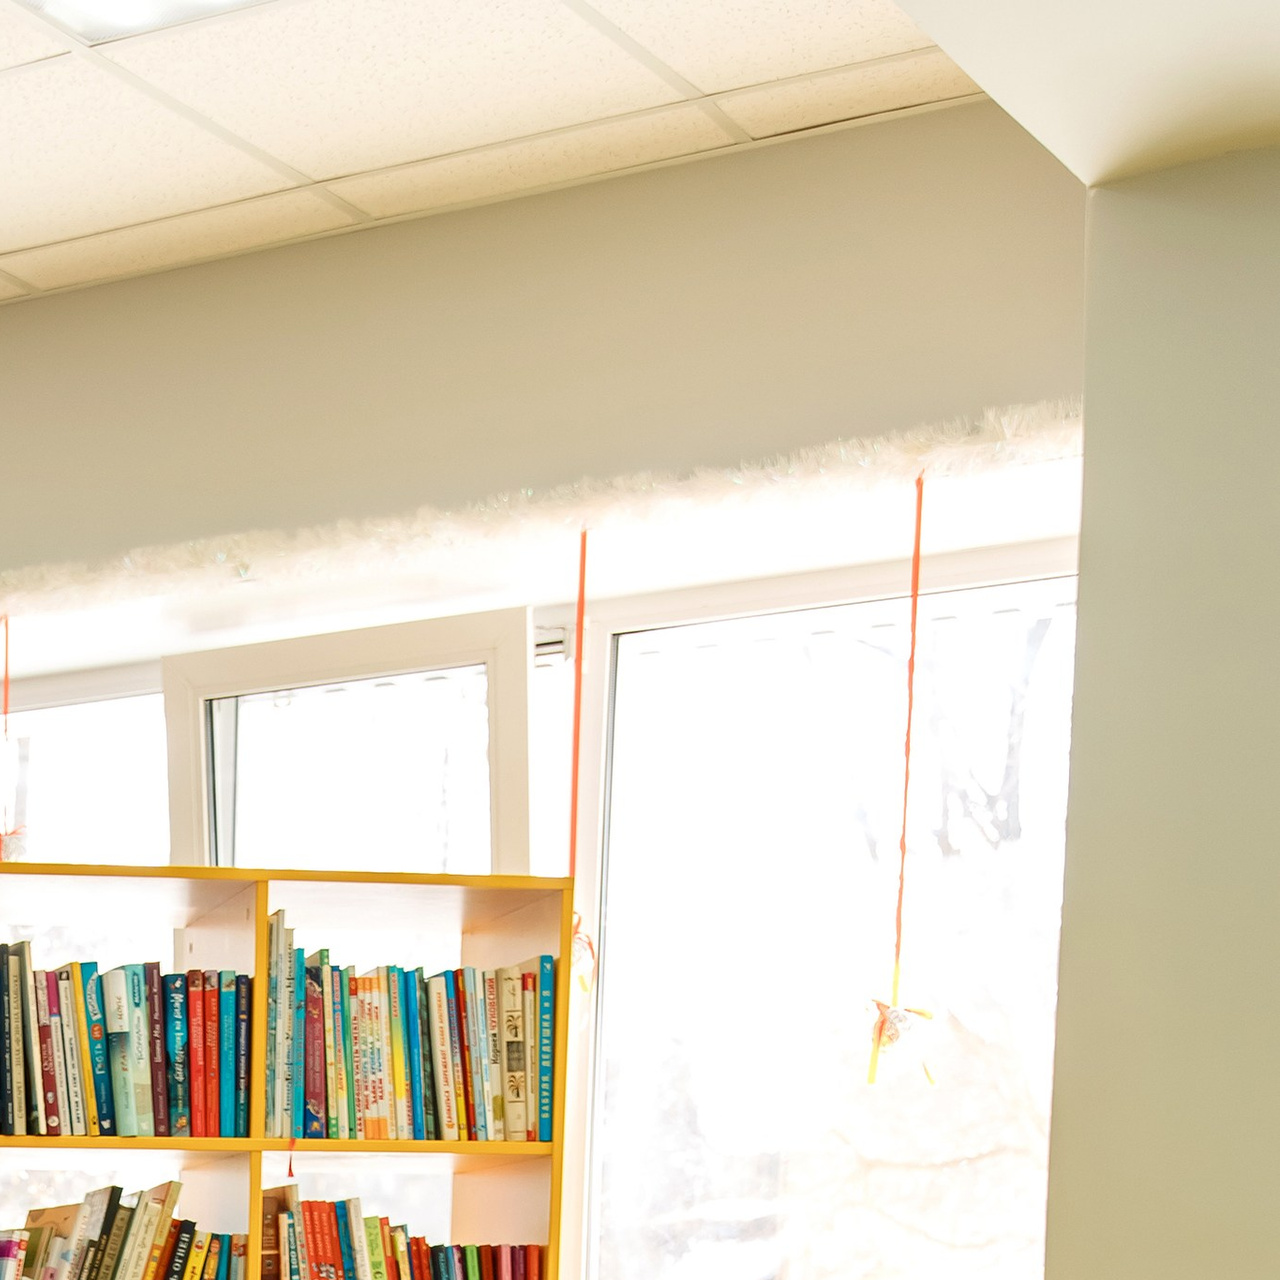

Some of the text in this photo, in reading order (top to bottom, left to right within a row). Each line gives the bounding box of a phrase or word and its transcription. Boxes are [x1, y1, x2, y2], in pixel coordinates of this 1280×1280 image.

[486, 978, 496, 1030] ЧУКОВСКИЙ
[541, 1014, 551, 1067] ДЕДУШКА
[170, 1233, 191, 1271] ОГНЕЙ
